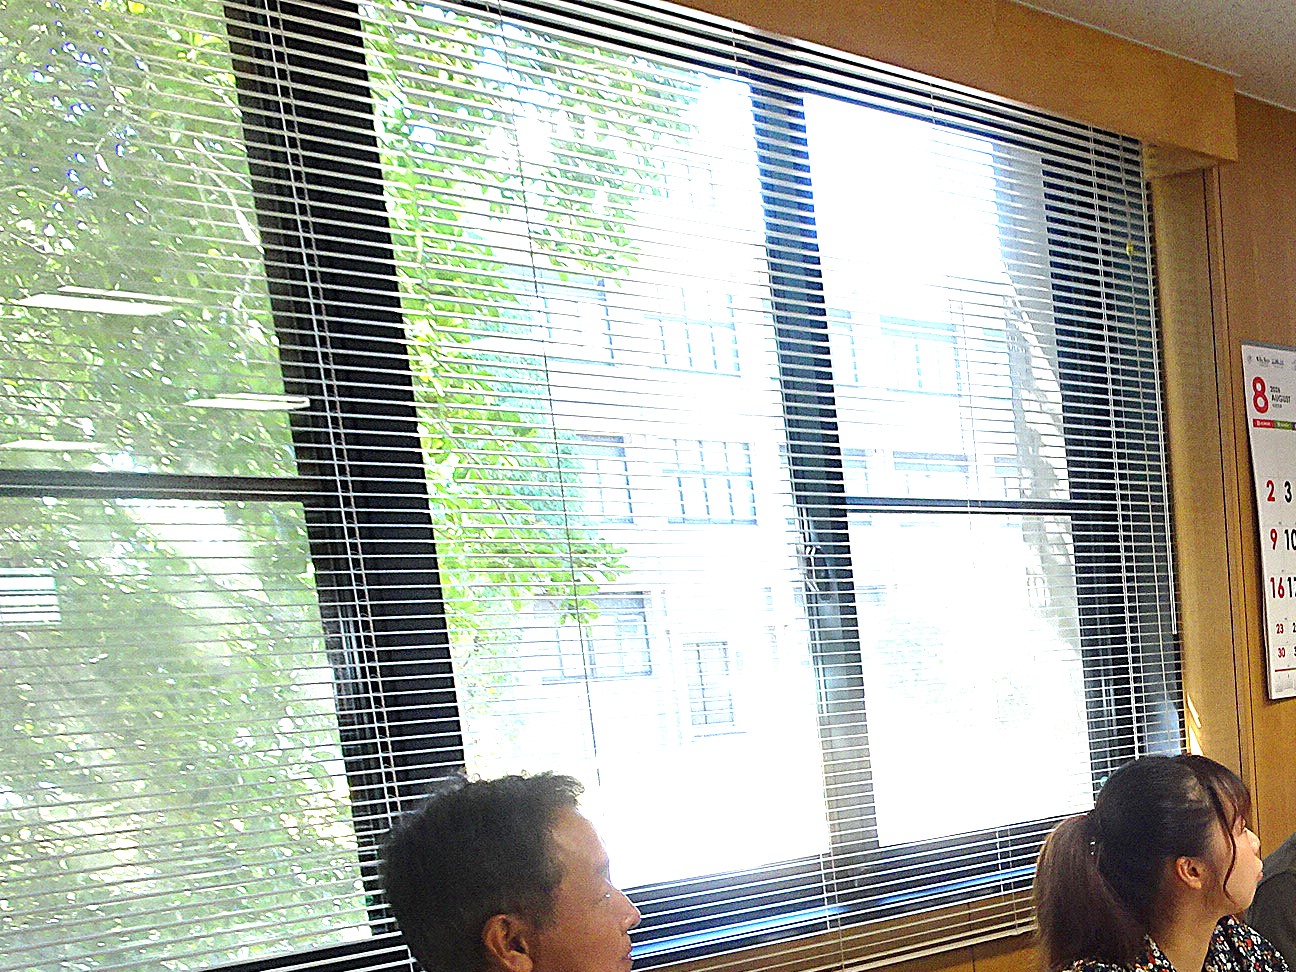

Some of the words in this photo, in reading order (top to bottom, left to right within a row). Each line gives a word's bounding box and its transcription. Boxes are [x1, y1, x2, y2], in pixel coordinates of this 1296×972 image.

[1252, 376, 1269, 413] 8
[1266, 480, 1276, 502] 2
[1284, 481, 1293, 503] 3
[1270, 528, 1278, 551] 9
[1270, 576, 1285, 599] 16
[1276, 623, 1284, 634] 23
[1277, 647, 1286, 658] 30
